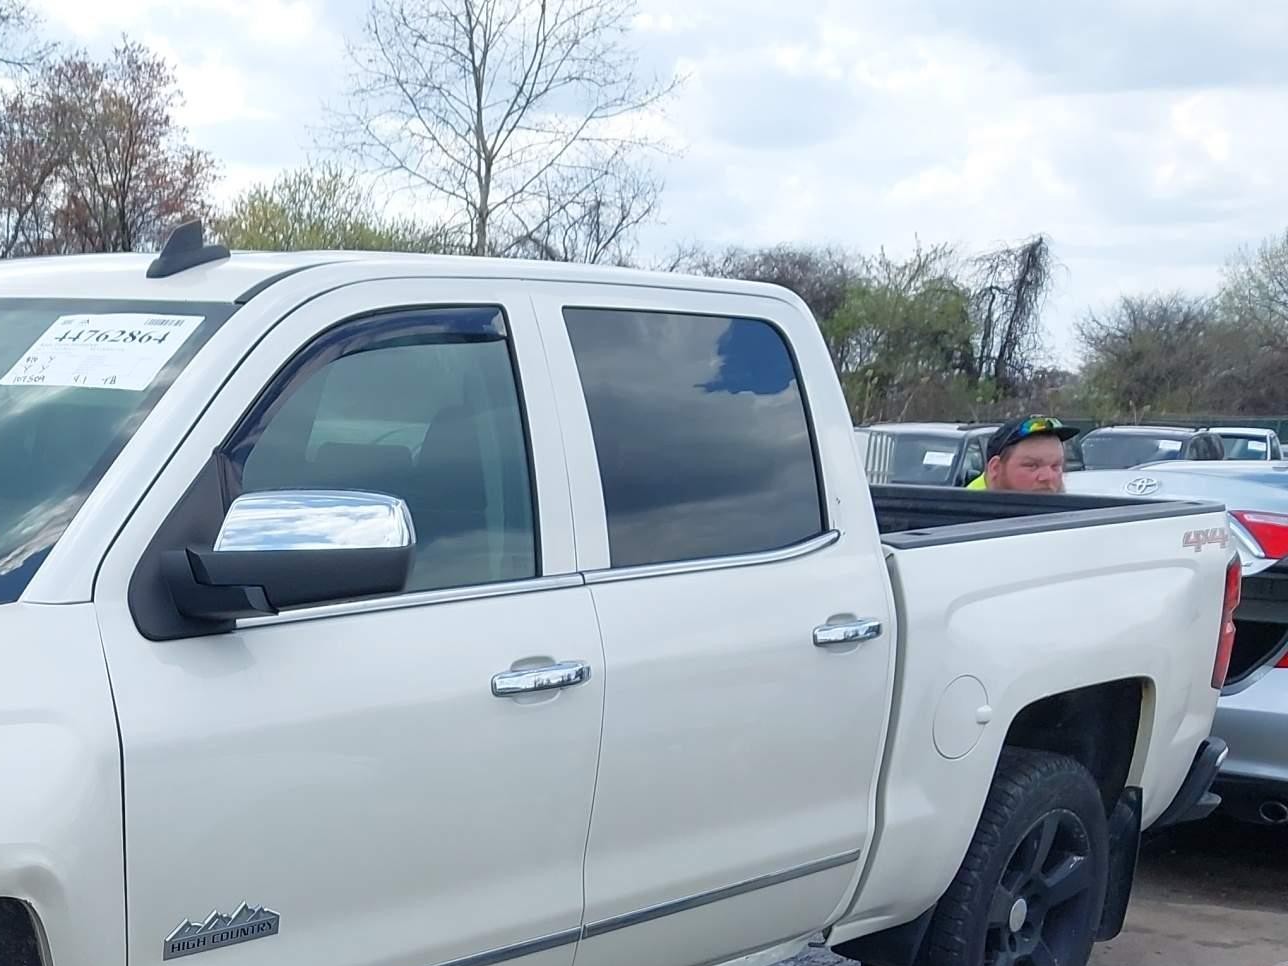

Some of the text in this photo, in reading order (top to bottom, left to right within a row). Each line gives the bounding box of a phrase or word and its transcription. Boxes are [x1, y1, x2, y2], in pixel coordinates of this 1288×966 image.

[54, 329, 171, 344] 44762864
[171, 919, 274, 953] HIGH COUNTRY
